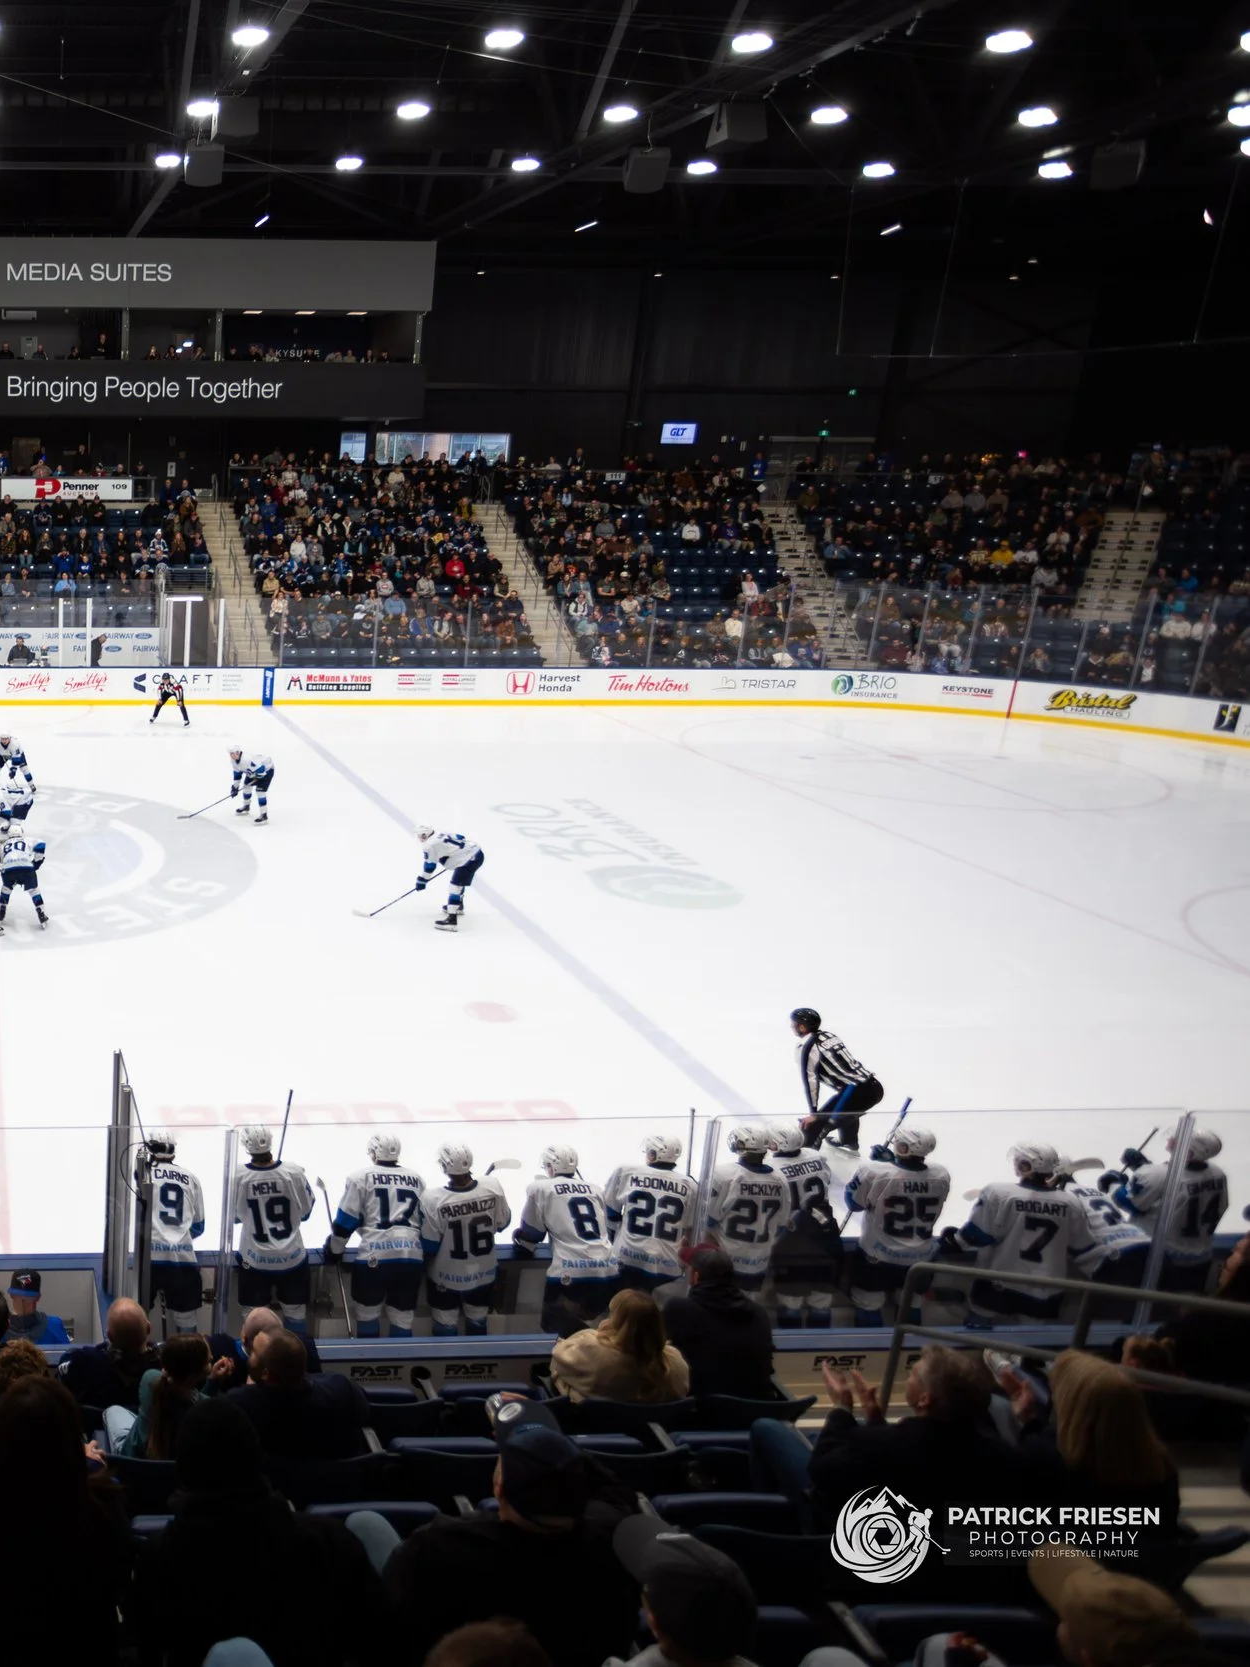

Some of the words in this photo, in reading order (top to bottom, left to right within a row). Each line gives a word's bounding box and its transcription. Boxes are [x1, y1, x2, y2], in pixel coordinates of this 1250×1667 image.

[6, 263, 83, 281] MEDIA
[90, 263, 172, 281] SUITES
[7, 376, 97, 403] Bringing
[105, 376, 179, 403] People
[186, 376, 282, 403] Together
[670, 427, 688, 436] GLT
[63, 481, 99, 491] Penner
[306, 674, 340, 682] McMunn
[350, 674, 372, 682] Yates
[539, 674, 581, 682] Harvest
[608, 674, 632, 692] Tim
[635, 674, 690, 692] Hortons
[741, 679, 797, 689] TRISTAR
[854, 674, 897, 690] BRIO
[538, 683, 572, 692] Honda
[851, 691, 898, 699] INSURANCE
[941, 685, 994, 694] KEYSTONE
[1070, 707, 1124, 718] HAULING
[490, 803, 649, 863] BRIO
[154, 1168, 190, 1185] CAIRNS
[372, 1173, 420, 1188] HOFFMAN
[252, 1181, 282, 1196] MEHL
[630, 1175, 688, 1197] McDONALD
[903, 1181, 929, 1194] HAN
[158, 1182, 185, 1226] 9
[1015, 1199, 1068, 1217] BOGART
[246, 1196, 294, 1243] 19
[567, 1196, 600, 1241] 8
[627, 1190, 685, 1243] 22
[725, 1198, 781, 1244] 27
[883, 1196, 940, 1240] 25
[448, 1214, 494, 1260] 16
[1020, 1215, 1060, 1263] 7
[369, 1240, 415, 1251] FAIRWAY
[562, 1258, 611, 1269] FAIRWAY
[439, 1271, 485, 1284] FAIRWAY
[814, 1355, 867, 1367] FAST
[350, 1365, 404, 1377] FAST
[445, 1363, 498, 1375] FAST
